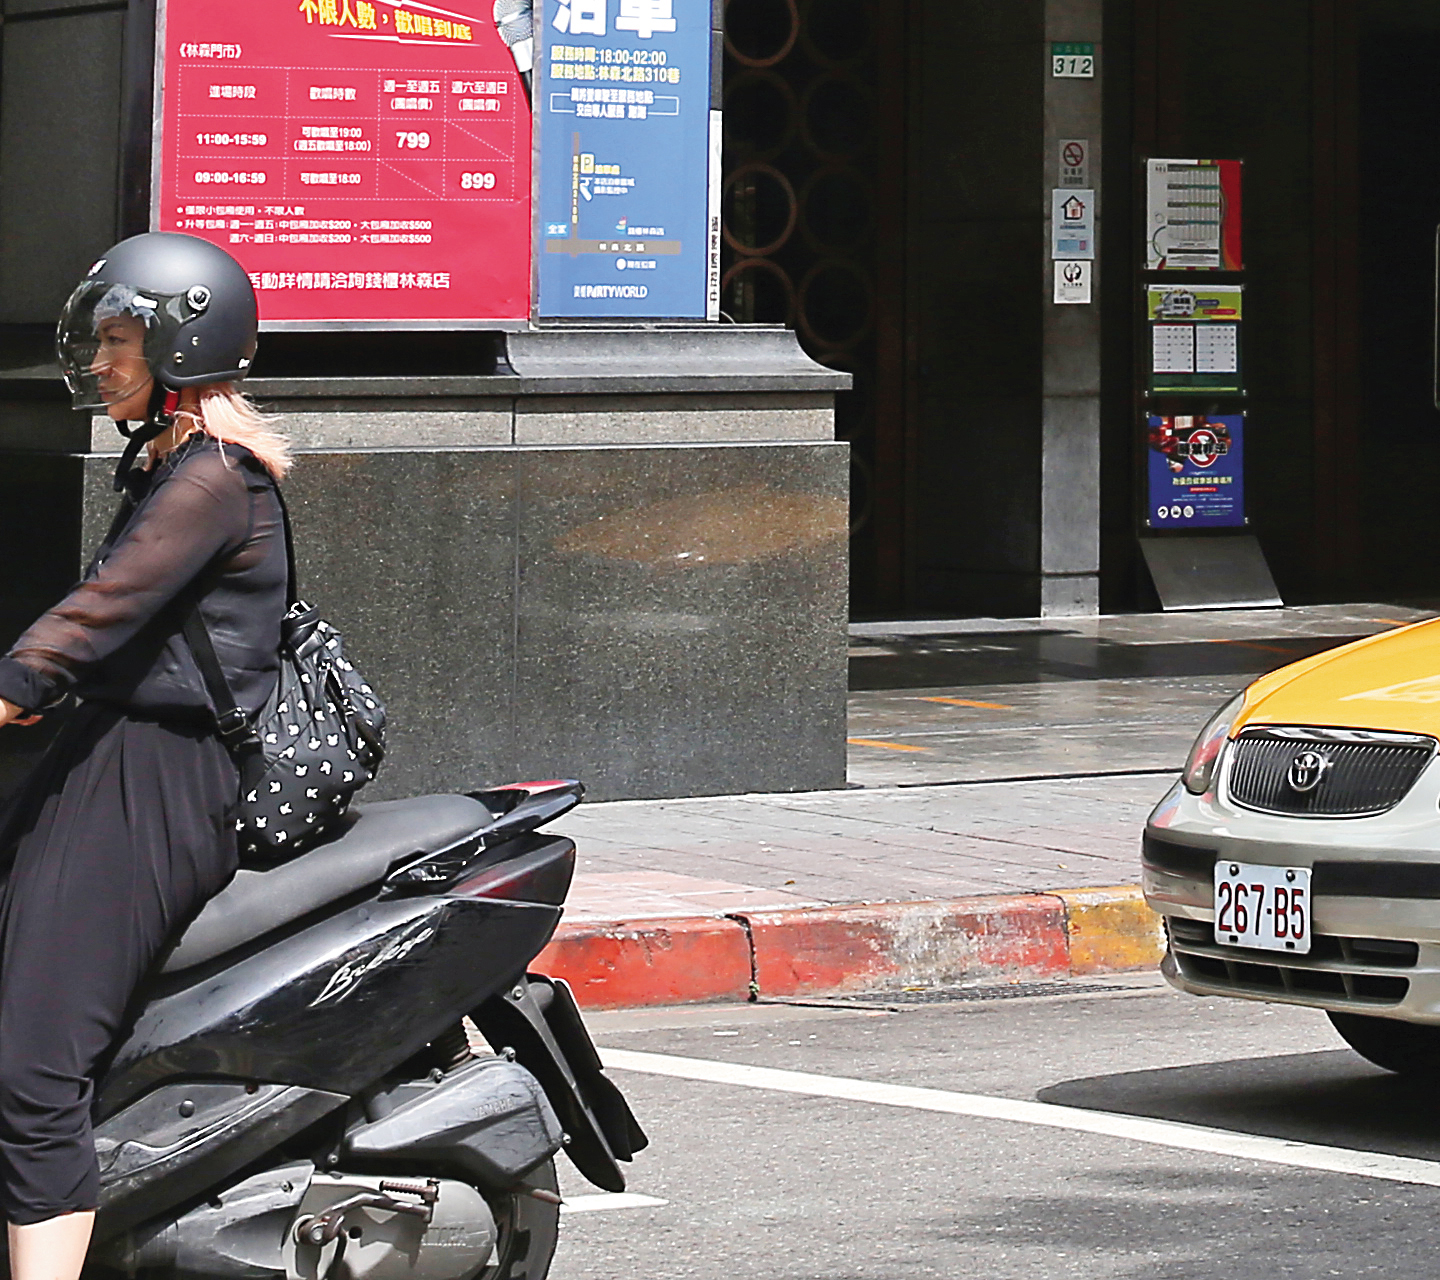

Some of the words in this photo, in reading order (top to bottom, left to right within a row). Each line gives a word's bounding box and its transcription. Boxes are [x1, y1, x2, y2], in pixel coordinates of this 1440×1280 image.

[1055, 58, 1092, 74] 312
[195, 132, 267, 146] 11:00-15:59
[395, 131, 431, 149] 799
[460, 172, 496, 190] 899
[1218, 881, 1305, 940] 267-B5
[473, 1097, 515, 1118] YAMAHA
